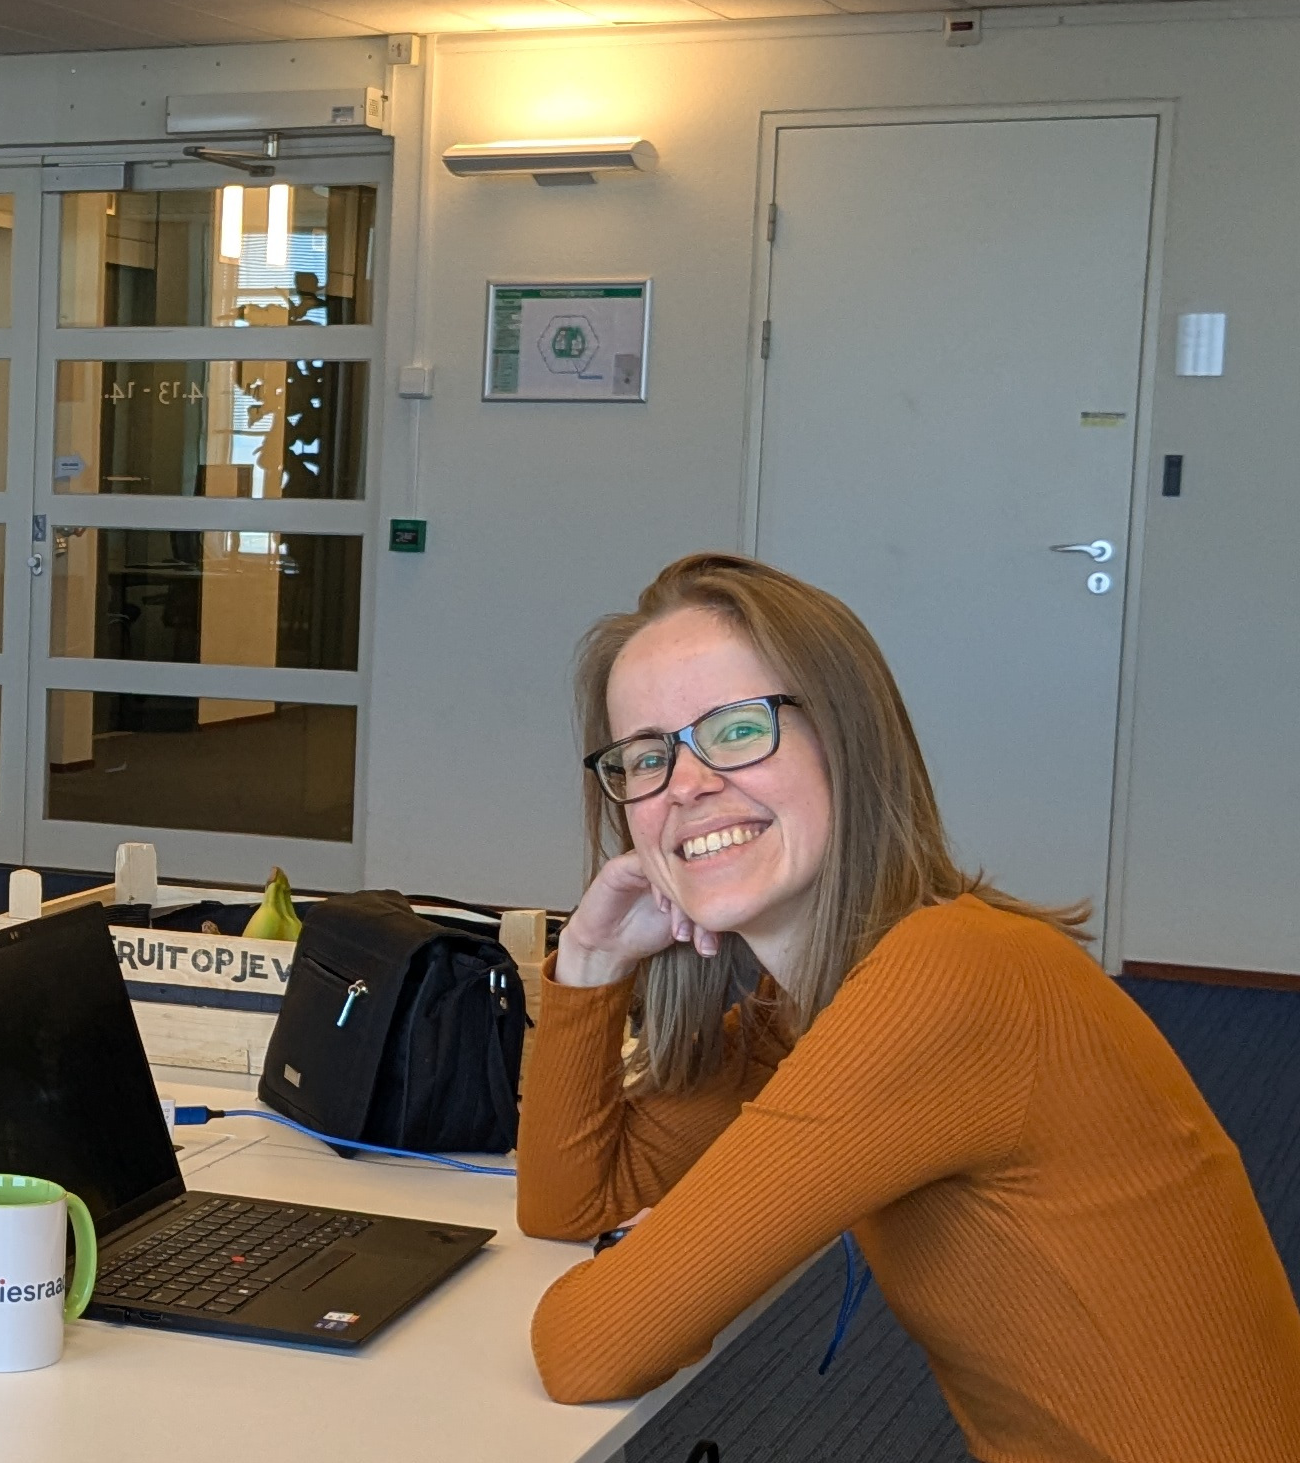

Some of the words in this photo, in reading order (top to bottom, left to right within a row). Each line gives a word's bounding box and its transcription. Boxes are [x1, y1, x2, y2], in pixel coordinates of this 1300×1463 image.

[111, 935, 188, 971] RUIT
[191, 947, 234, 975] OP
[231, 950, 268, 983] JE
